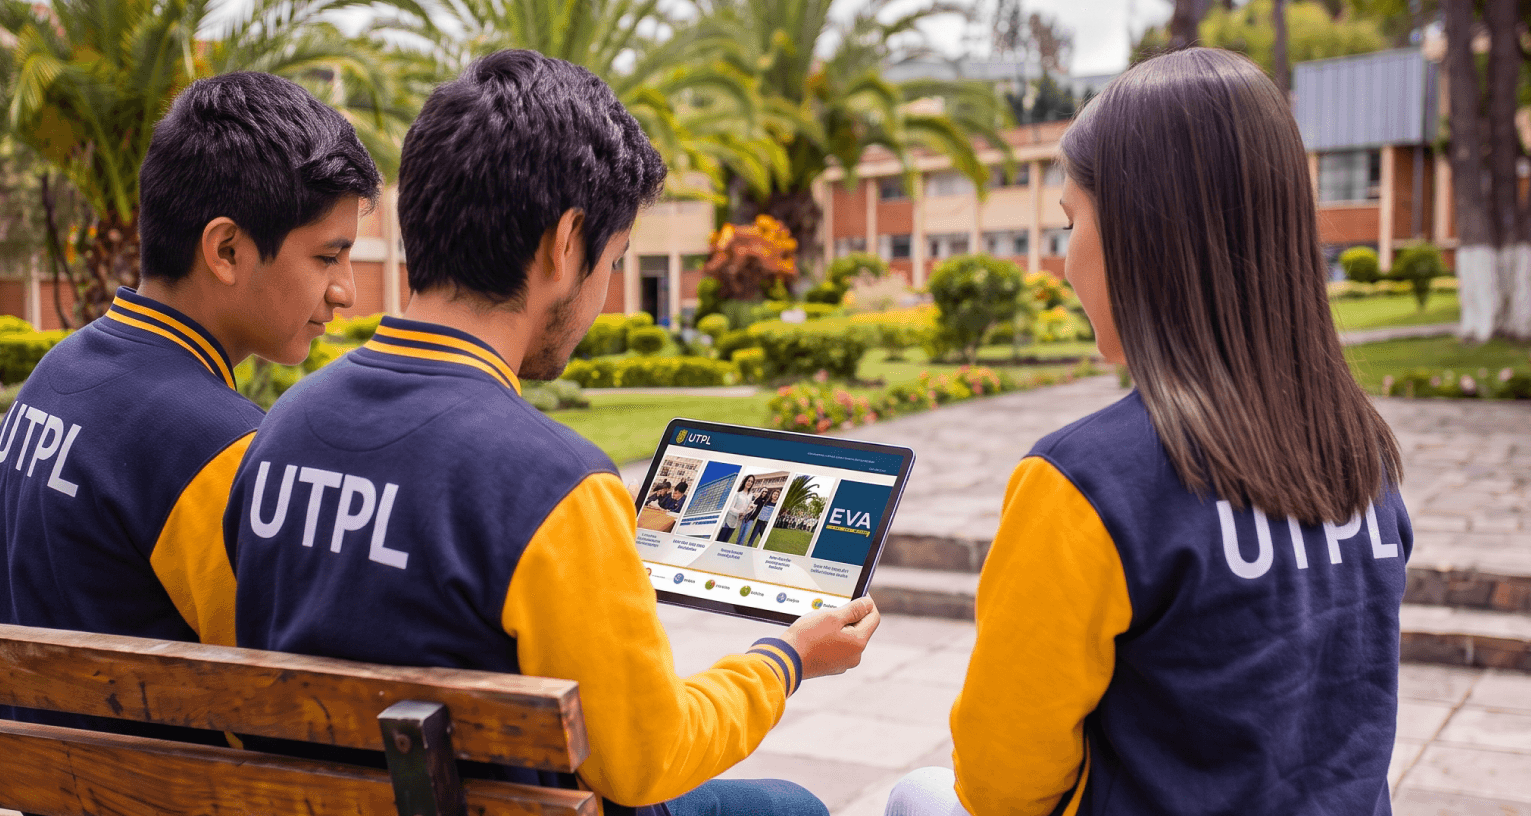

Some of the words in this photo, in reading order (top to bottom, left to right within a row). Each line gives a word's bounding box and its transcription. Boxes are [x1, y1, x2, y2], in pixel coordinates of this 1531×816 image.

[688, 433, 711, 446] UTPL
[249, 460, 409, 570] UTPL
[829, 508, 871, 530] EVA
